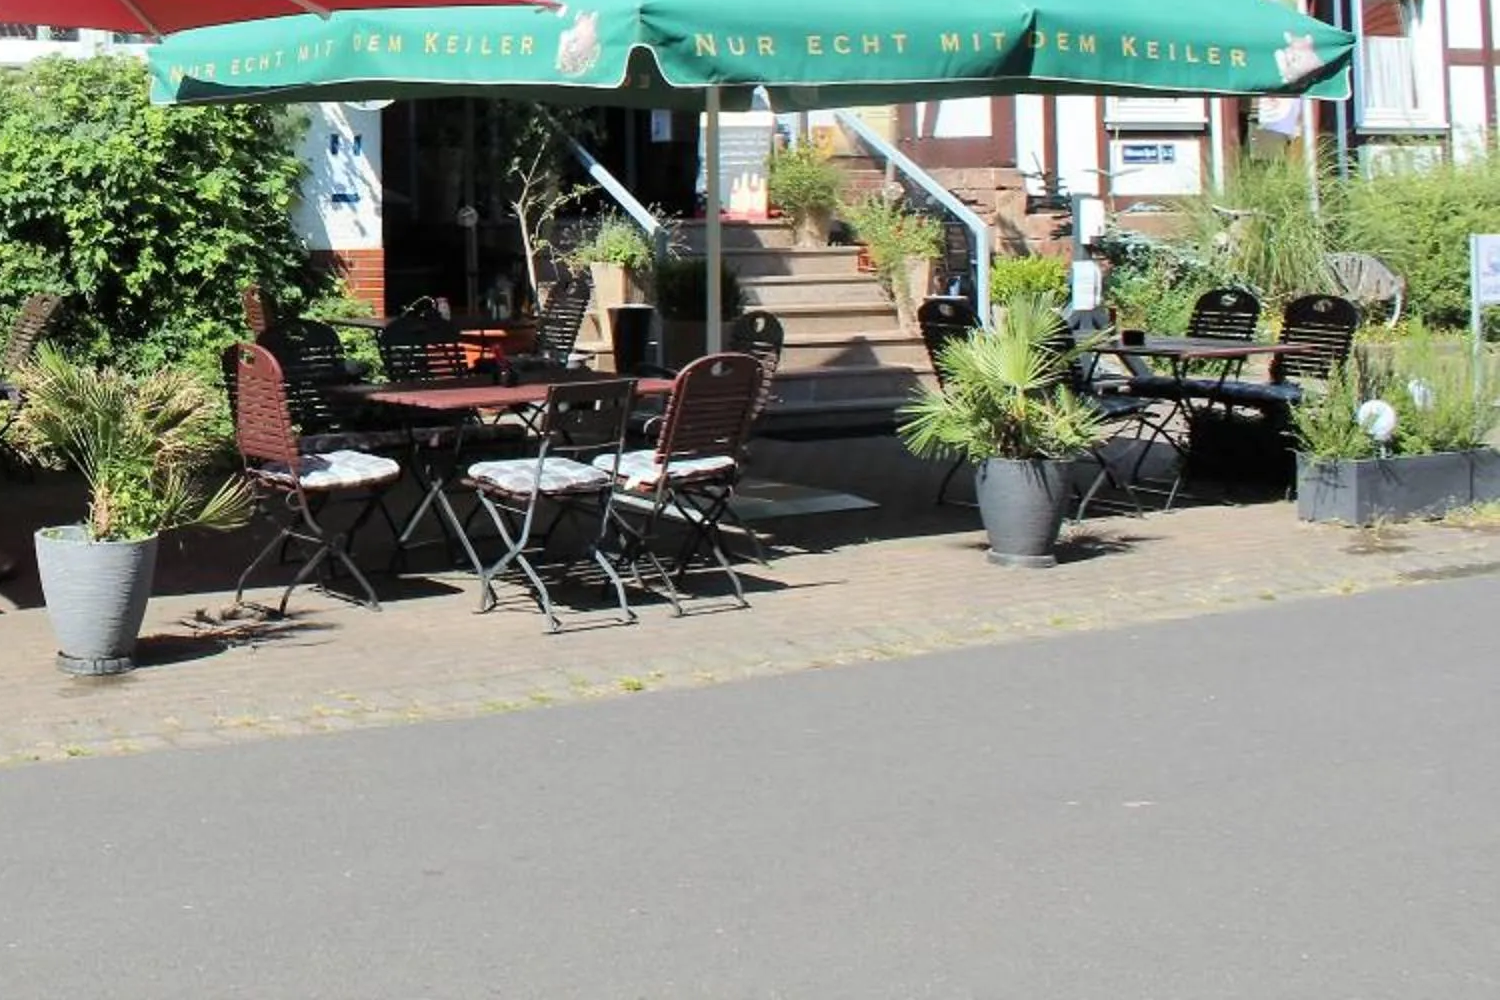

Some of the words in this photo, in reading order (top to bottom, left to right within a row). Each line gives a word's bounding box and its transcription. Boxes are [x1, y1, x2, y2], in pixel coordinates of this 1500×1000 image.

[169, 63, 216, 84] NUR
[230, 50, 285, 76] ECHT
[297, 39, 335, 63] MIT
[353, 33, 402, 54] DEM
[424, 31, 536, 56] KEILER
[694, 33, 775, 57] NUR
[806, 34, 907, 55] ECHT
[941, 32, 1007, 52] MIT
[1028, 31, 1096, 53] DEM
[1121, 35, 1247, 67] KEILER
